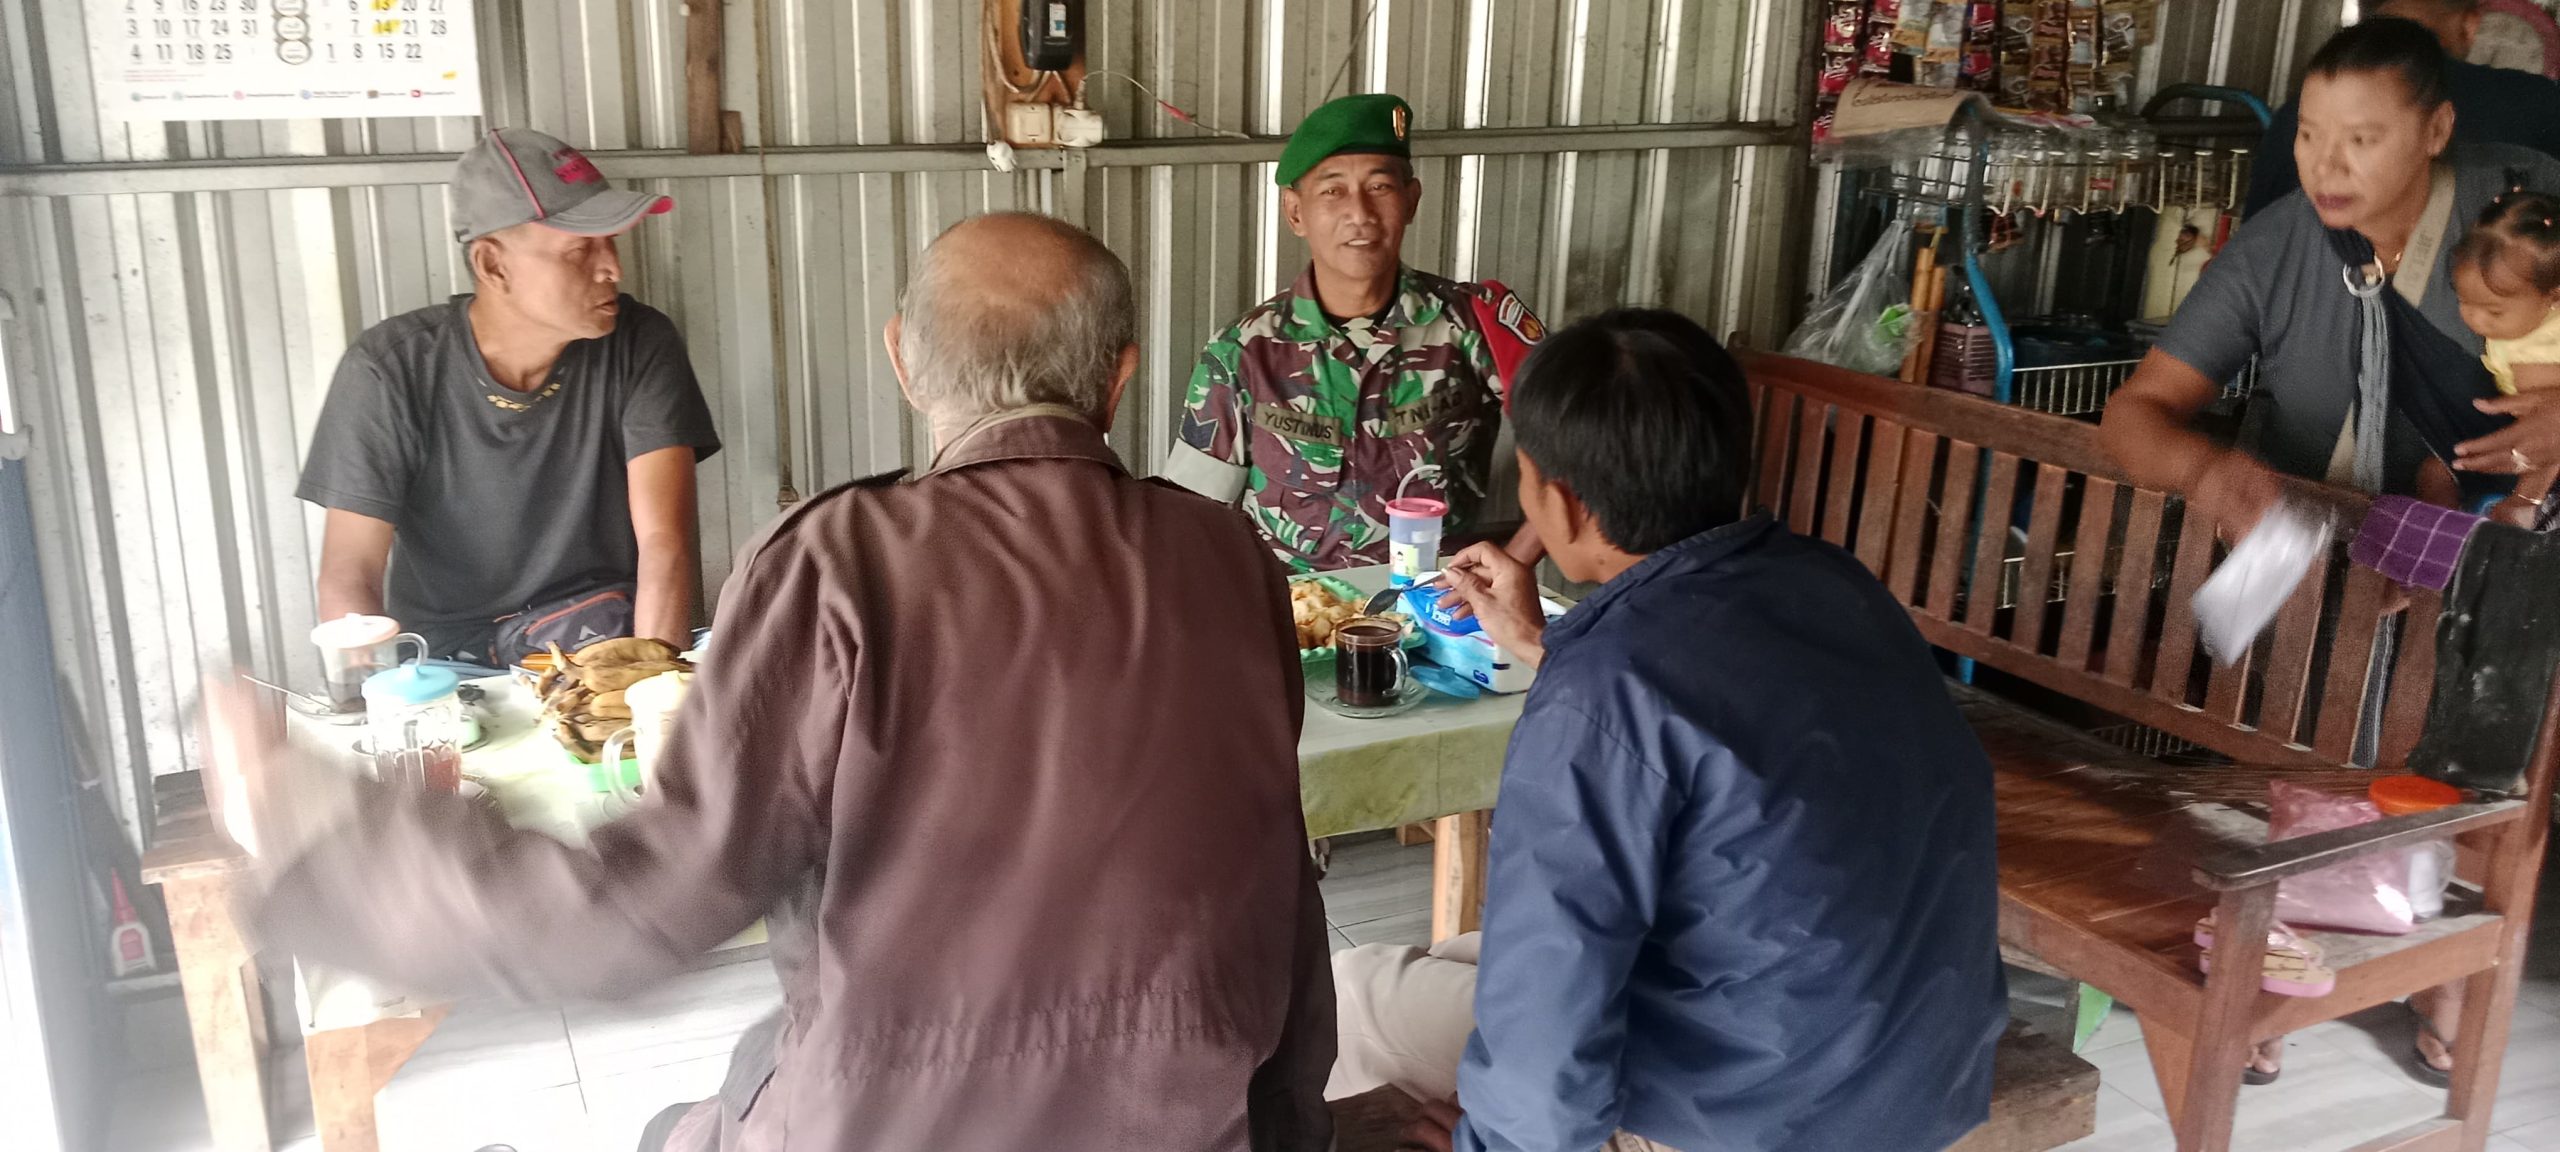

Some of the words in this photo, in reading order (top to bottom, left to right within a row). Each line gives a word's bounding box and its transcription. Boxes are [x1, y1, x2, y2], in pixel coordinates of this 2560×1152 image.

[126, 18, 138, 36] 3
[153, 18, 171, 36] 10
[183, 18, 201, 36] 17
[211, 18, 229, 36] 24
[241, 18, 258, 36] 31
[351, 18, 360, 35] 7
[375, 18, 393, 35] 14
[402, 18, 418, 35] 21
[430, 18, 447, 35] 28
[130, 43, 142, 60] 4
[156, 43, 174, 60] 11
[186, 43, 205, 60] 18
[213, 43, 232, 60] 25
[326, 42, 336, 59] 1
[353, 42, 363, 59] 8
[377, 42, 395, 59] 15
[404, 42, 422, 59] 22
[1264, 412, 1334, 440] YUSTINUS
